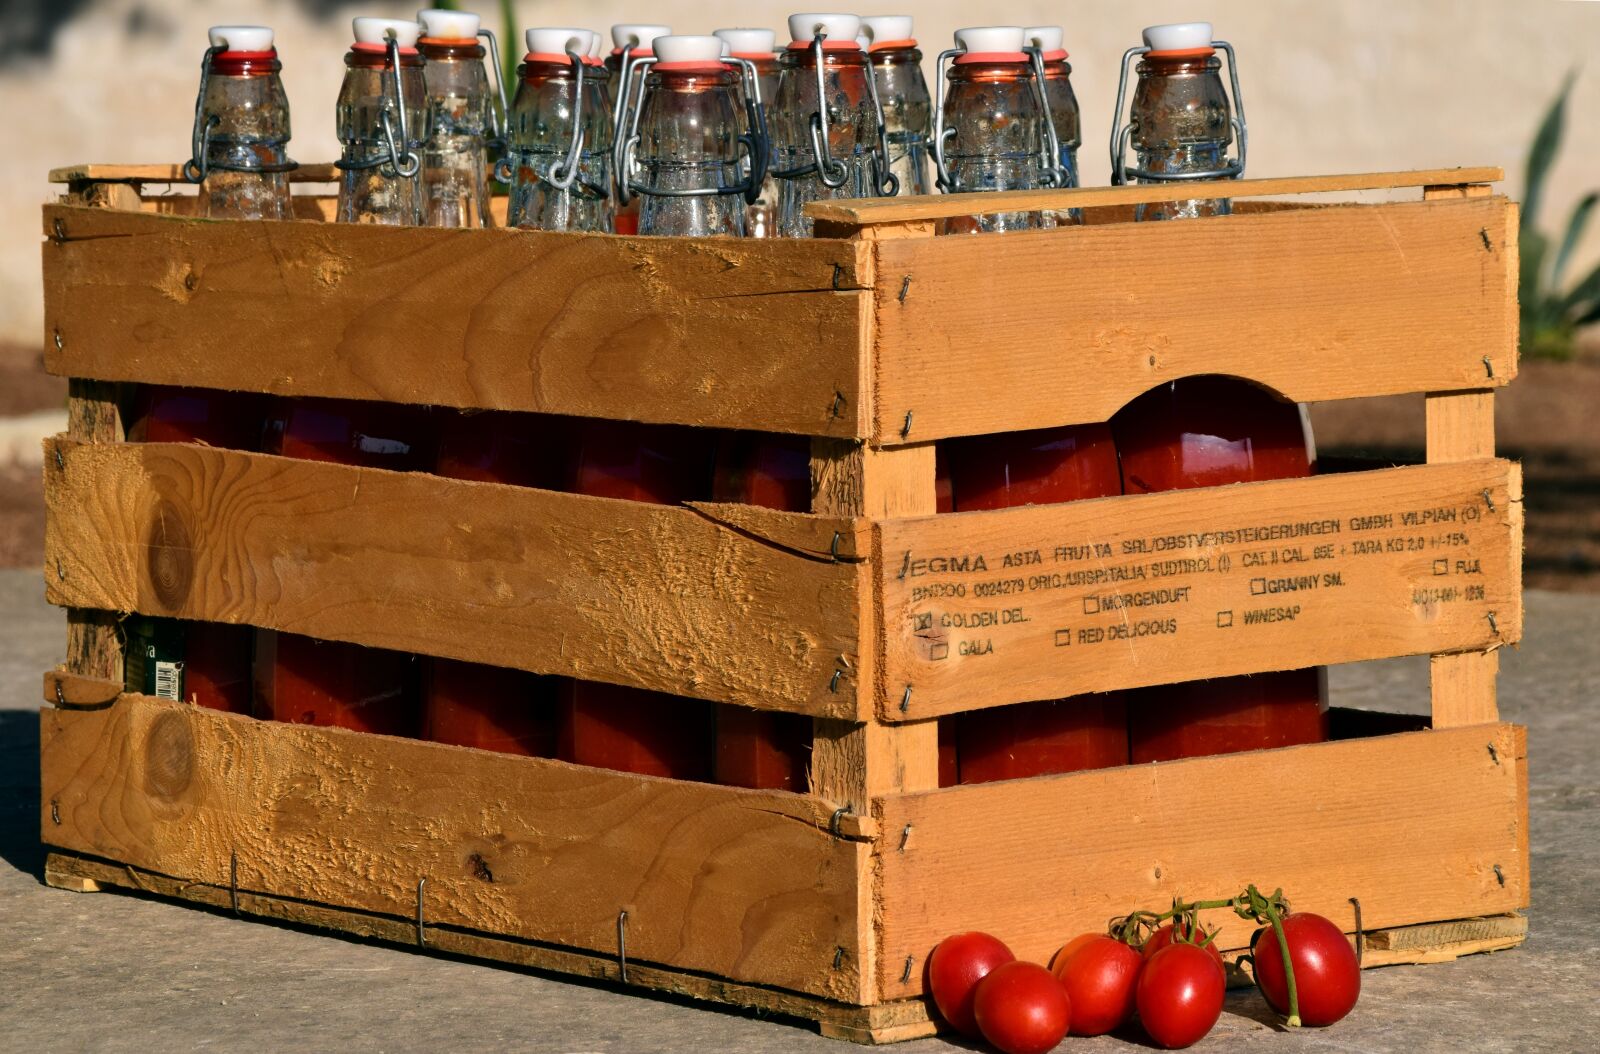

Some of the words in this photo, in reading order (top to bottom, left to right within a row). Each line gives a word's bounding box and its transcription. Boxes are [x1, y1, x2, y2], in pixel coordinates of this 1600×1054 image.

[910, 554, 988, 577] EGMA
[1002, 549, 1042, 568] ASTA
[1054, 542, 1113, 562] FRUTTA
[1349, 513, 1393, 531] GMBH
[1401, 507, 1456, 526] VILPIAN
[973, 578, 1025, 597] 0024279
[1352, 538, 1383, 555] TARA
[1386, 537, 1404, 552] KG
[1267, 574, 1320, 594] GRANNY
[1102, 585, 1192, 611] MORGENDUFT
[941, 610, 998, 629] GOLDEN
[1002, 607, 1032, 625] DEL.
[1243, 605, 1301, 625] WINESAP
[1078, 627, 1104, 644] RED
[1108, 618, 1177, 640] DELICIOUS
[958, 639, 994, 656] GALA
